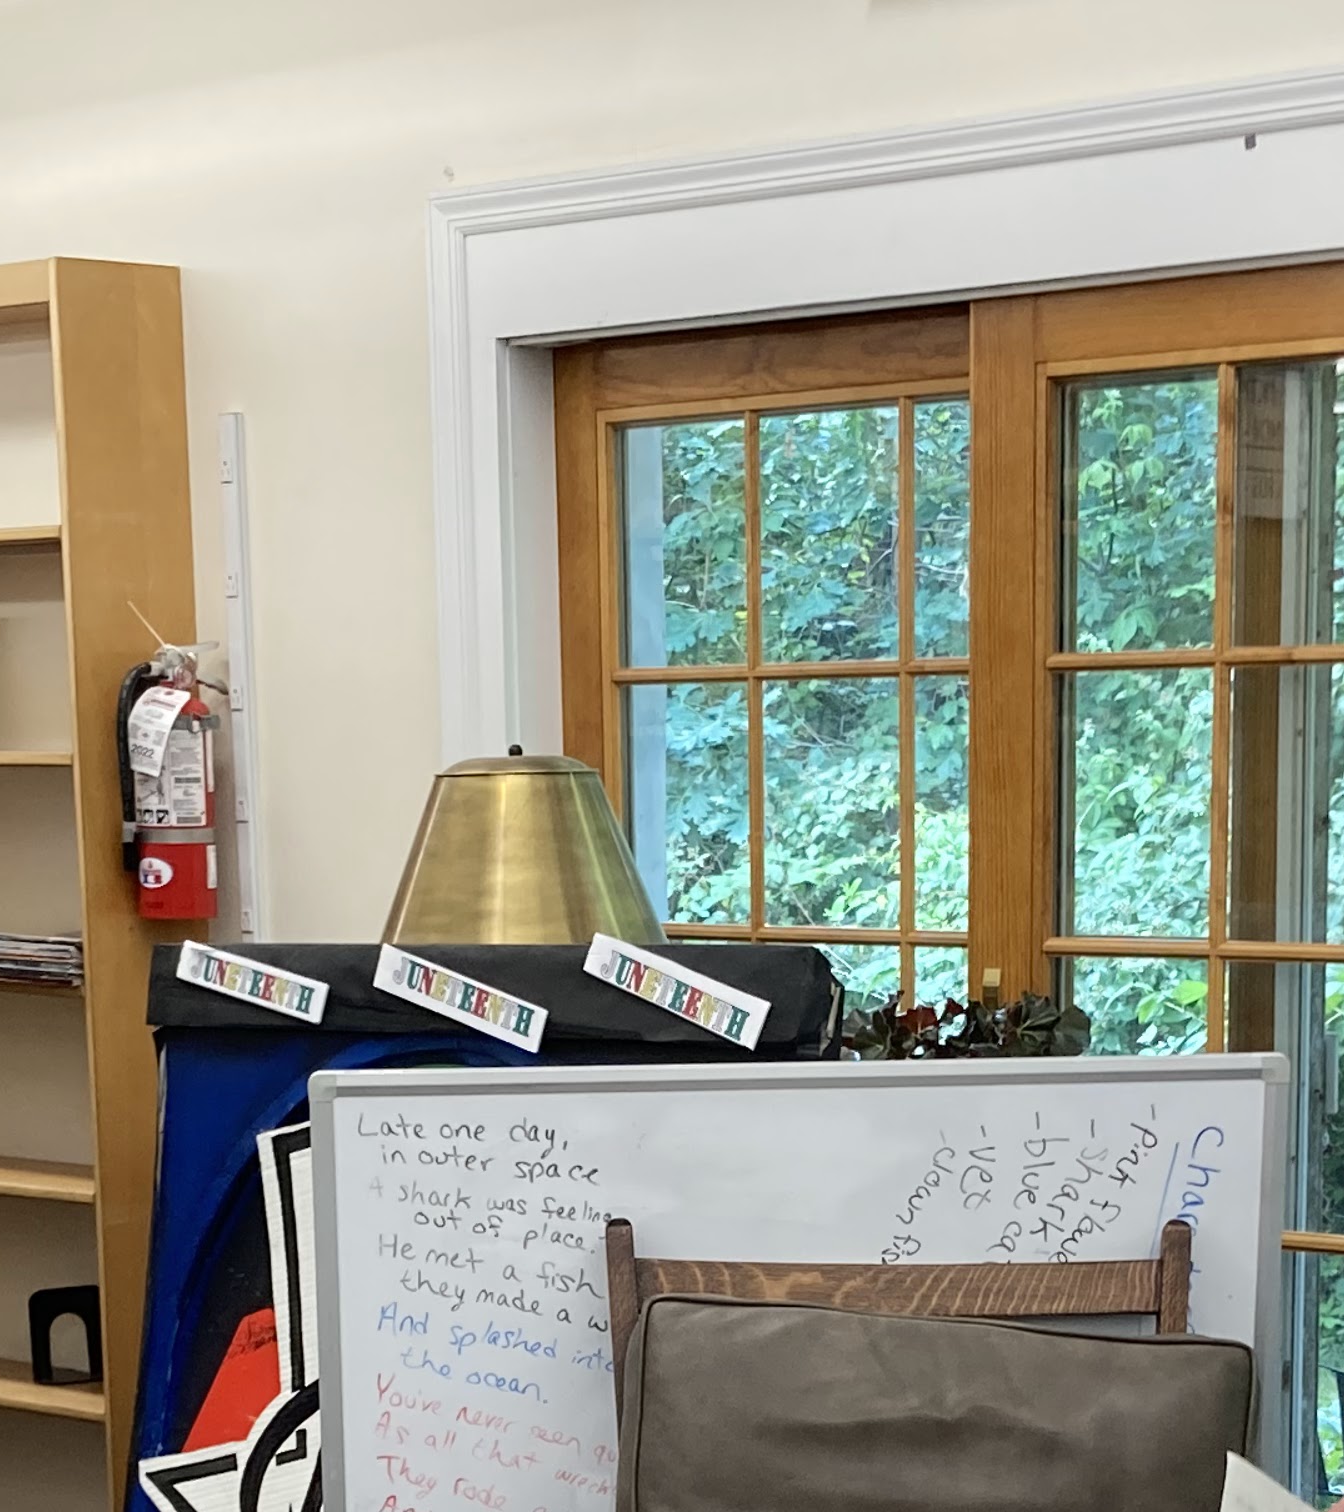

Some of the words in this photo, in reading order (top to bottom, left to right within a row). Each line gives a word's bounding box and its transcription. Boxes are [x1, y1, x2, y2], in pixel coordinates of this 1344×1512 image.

[191, 953, 316, 1015] JUNETEENTH
[392, 956, 536, 1038] JUNETEENTH
[600, 950, 750, 1041] JUNETEENTH
[358, 1113, 427, 1139] Late
[440, 1122, 486, 1142] one
[509, 1117, 568, 1159] day,
[382, 1144, 407, 1165] in
[419, 1145, 494, 1173] outer
[515, 1159, 601, 1186] space
[1013, 1138, 1070, 1210] blue
[487, 1195, 527, 1215] was
[414, 1209, 461, 1229] out
[472, 1215, 504, 1237] of
[523, 1223, 596, 1255] place.
[881, 1234, 922, 1264] fis
[985, 1220, 1023, 1264] ca
[1047, 1198, 1122, 1265] flowe
[378, 1233, 417, 1262] He
[425, 1248, 485, 1273] met
[502, 1263, 522, 1283] a
[536, 1261, 605, 1299] fish
[376, 1302, 428, 1334] And
[400, 1271, 465, 1312] they
[476, 1283, 544, 1317] made
[556, 1306, 572, 1325] a
[466, 1371, 549, 1405] ocean.
[375, 1410, 410, 1445] As
[424, 1430, 456, 1451] all
[471, 1437, 542, 1471] that
[456, 1405, 516, 1434] never
[376, 1455, 438, 1500] They
[452, 1477, 508, 1512] rode
[554, 1467, 617, 1497] wreck
